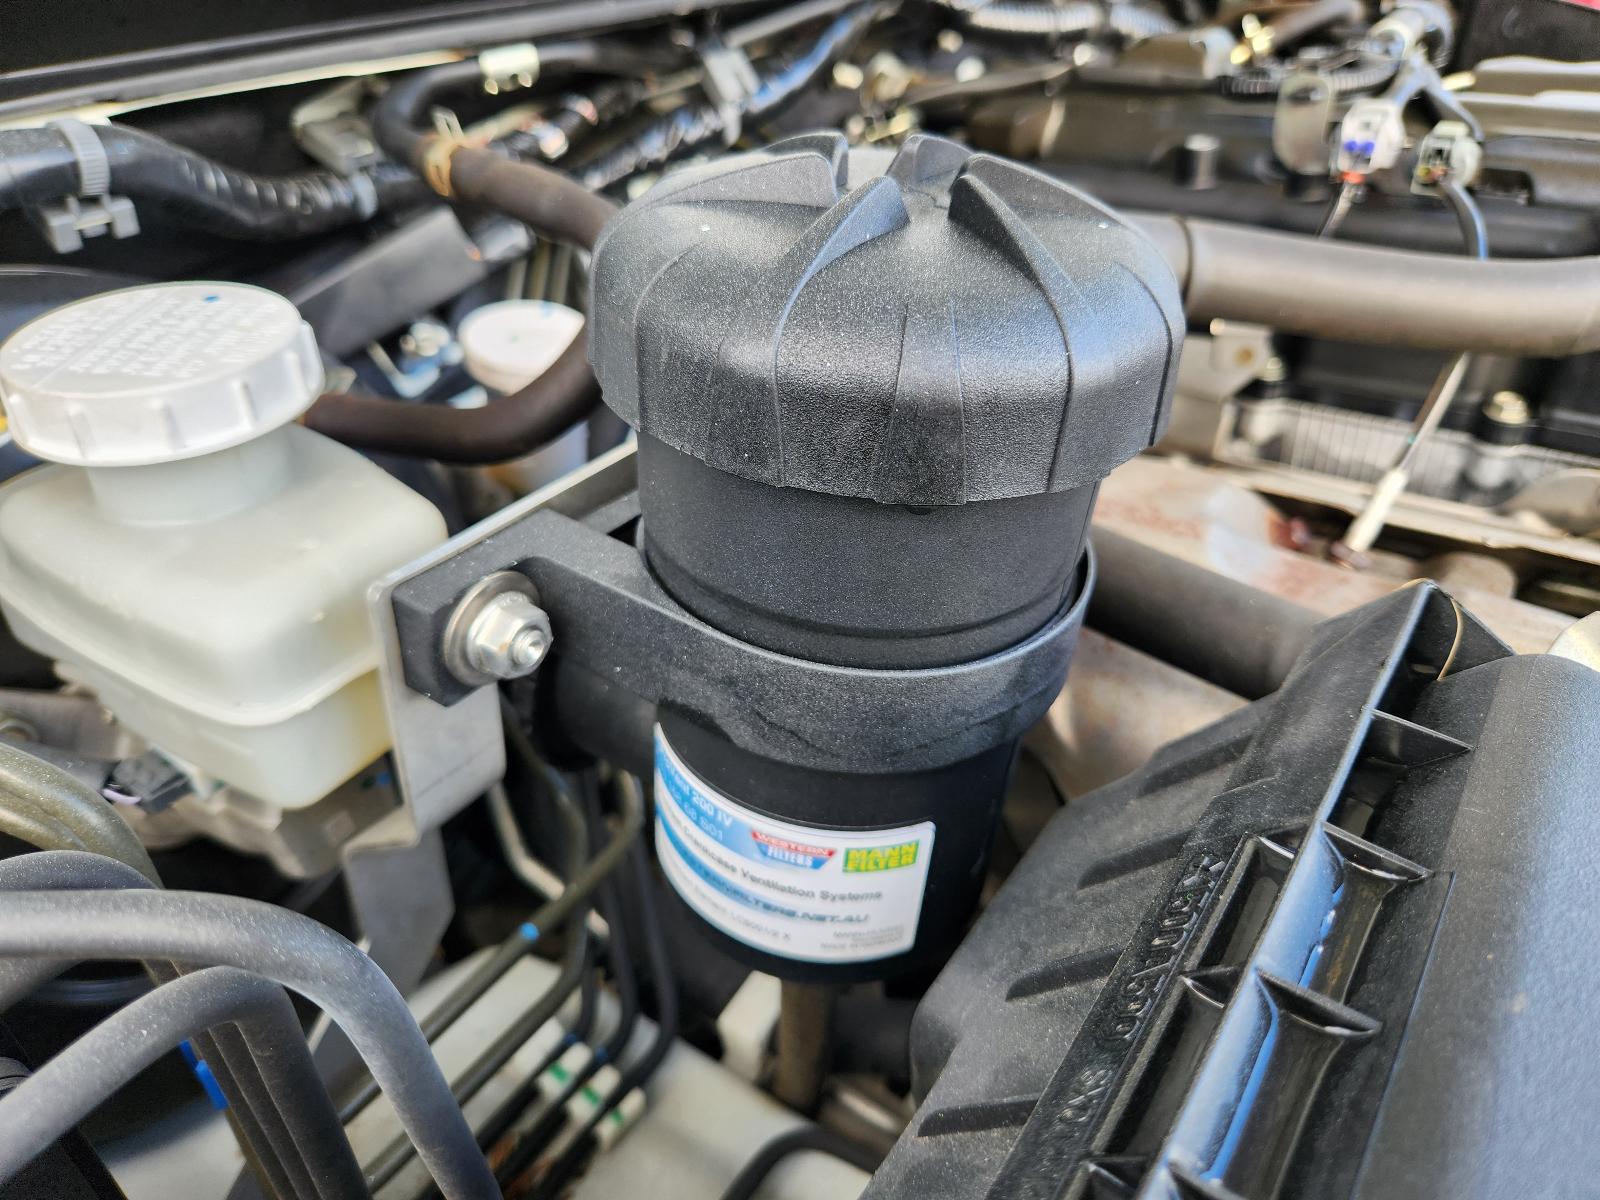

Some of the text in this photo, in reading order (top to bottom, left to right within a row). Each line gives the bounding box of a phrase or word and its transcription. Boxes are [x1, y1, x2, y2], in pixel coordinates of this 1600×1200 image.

[692, 790, 715, 816] 200
[760, 832, 829, 856] WESTERN
[848, 841, 917, 860] MANN
[768, 845, 813, 867] FILTERS
[847, 854, 914, 872] FILTER
[740, 867, 815, 899] Ventilation
[819, 890, 883, 902] Systems
